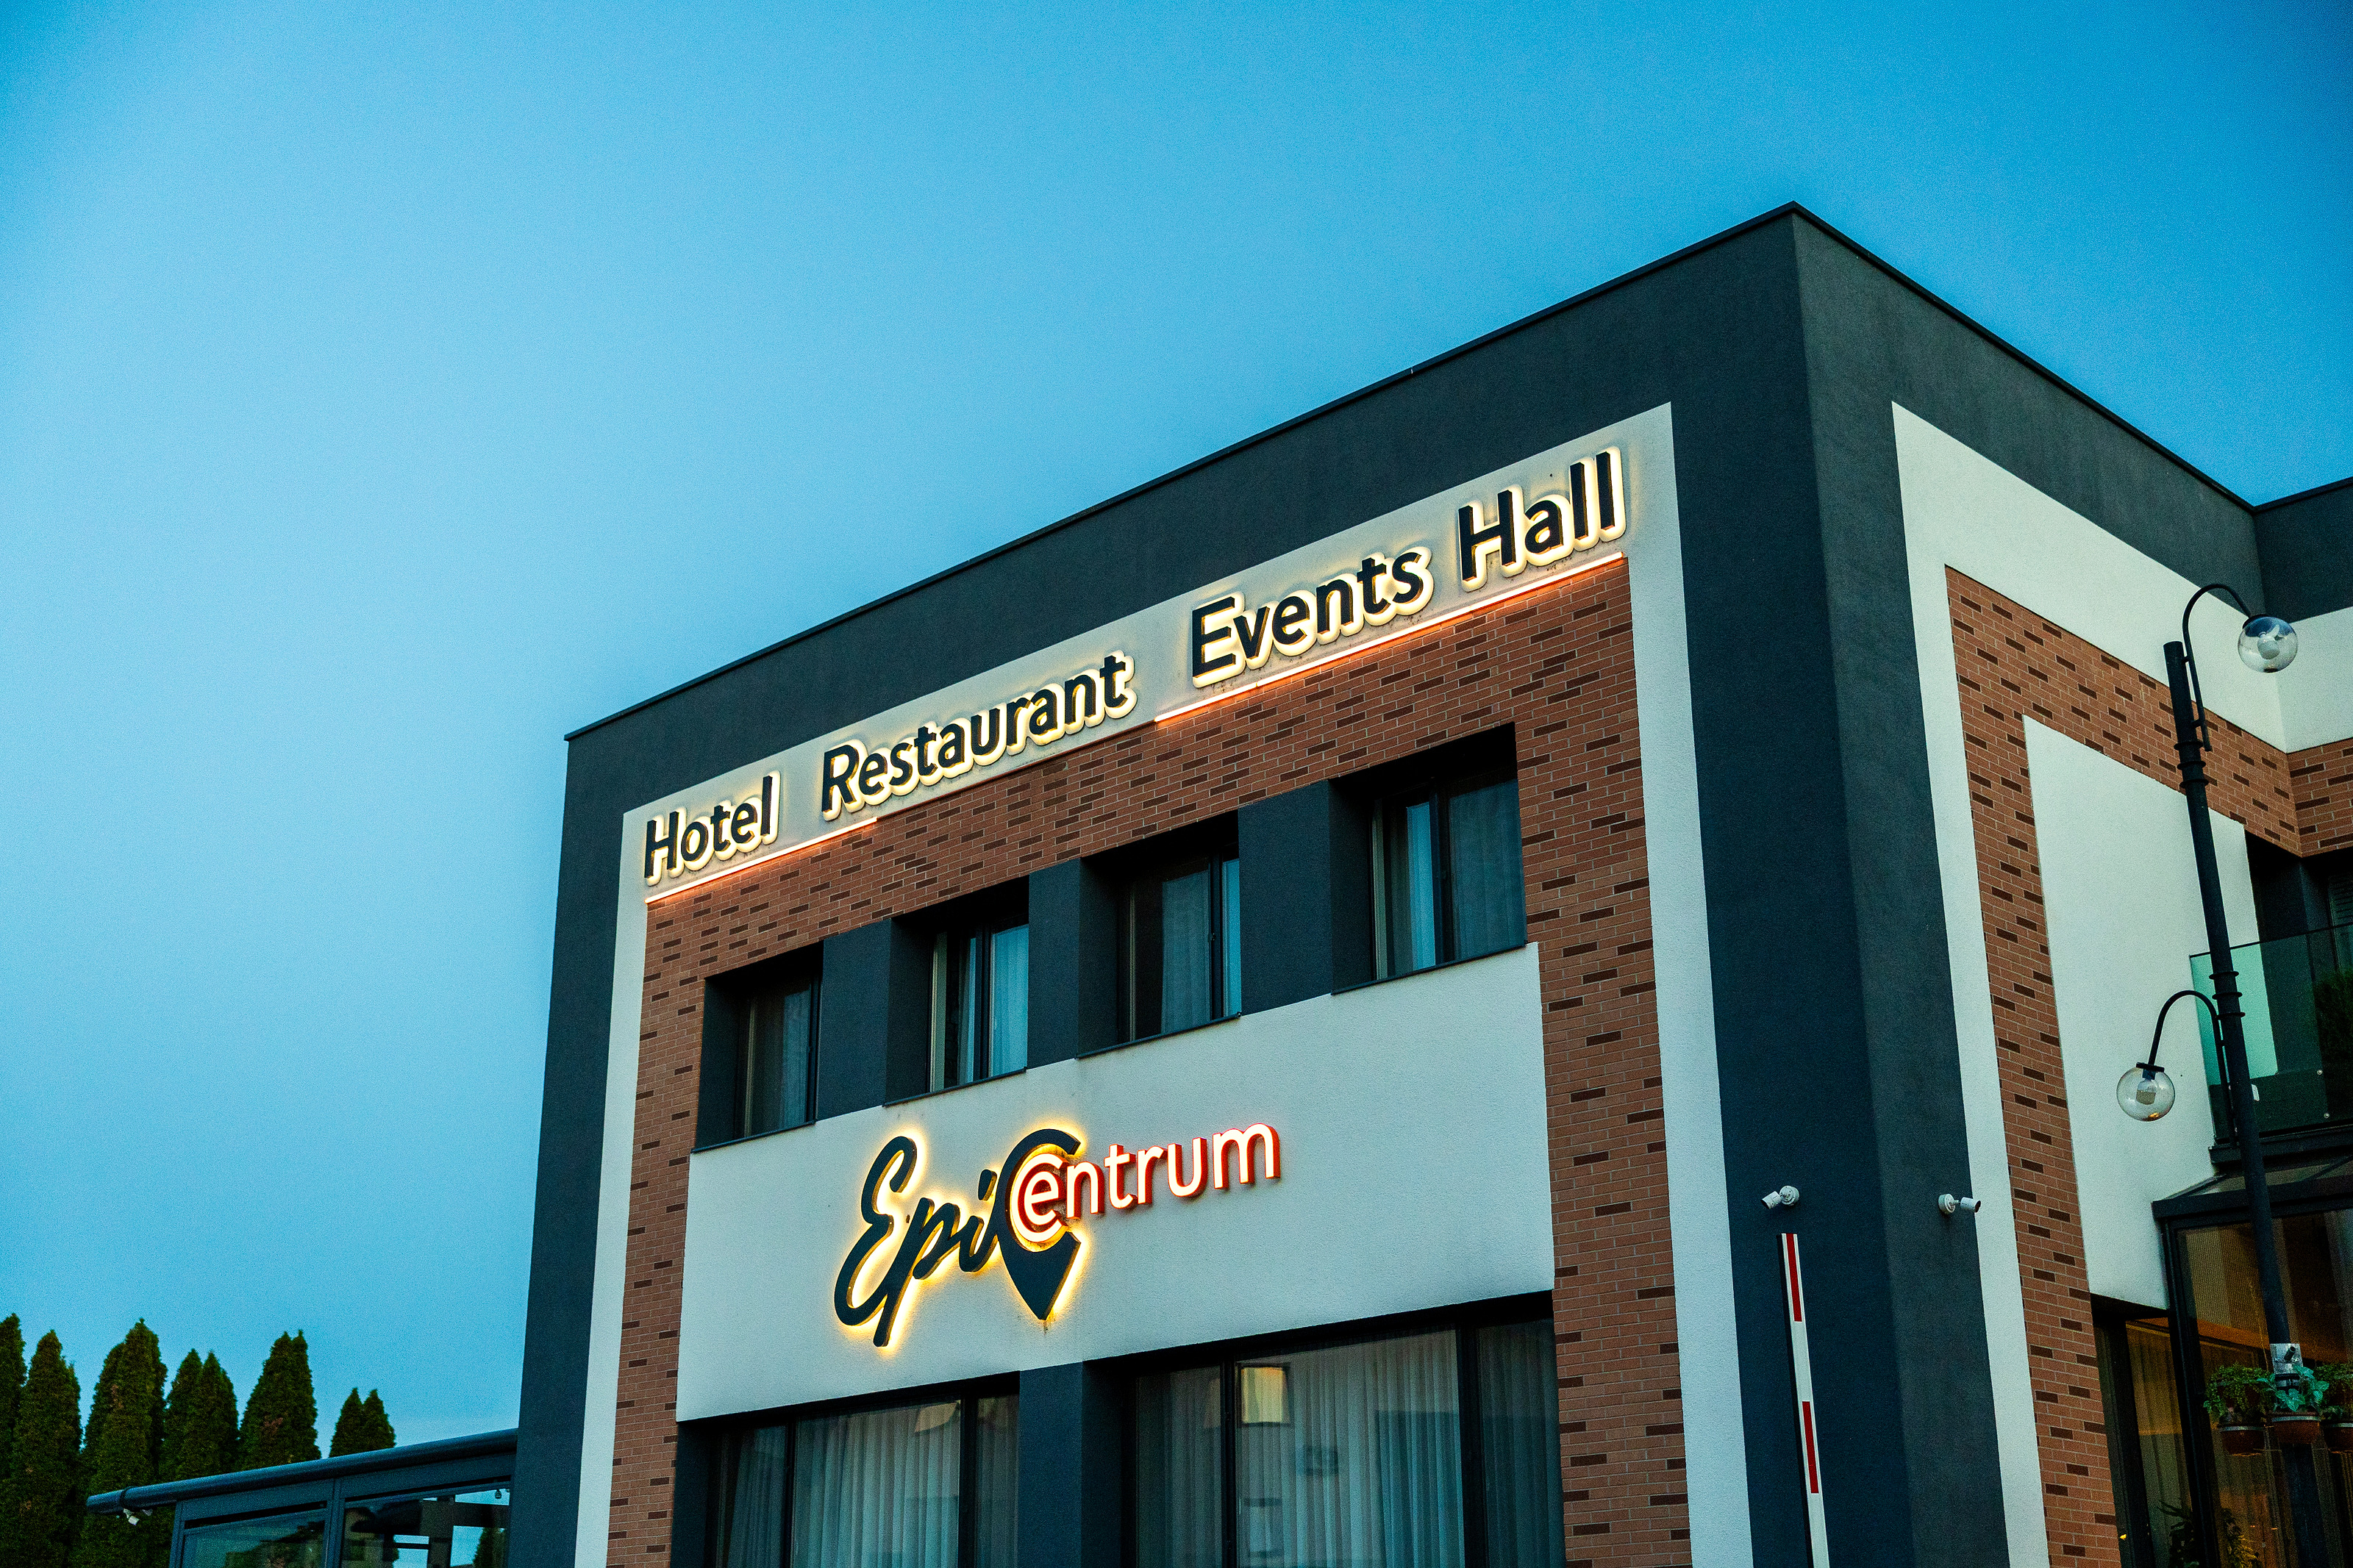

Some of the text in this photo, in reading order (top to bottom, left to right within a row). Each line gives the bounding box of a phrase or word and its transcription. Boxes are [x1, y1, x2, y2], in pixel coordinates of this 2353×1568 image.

[644, 450, 1616, 881] Hotel Restaurant Events Hall
